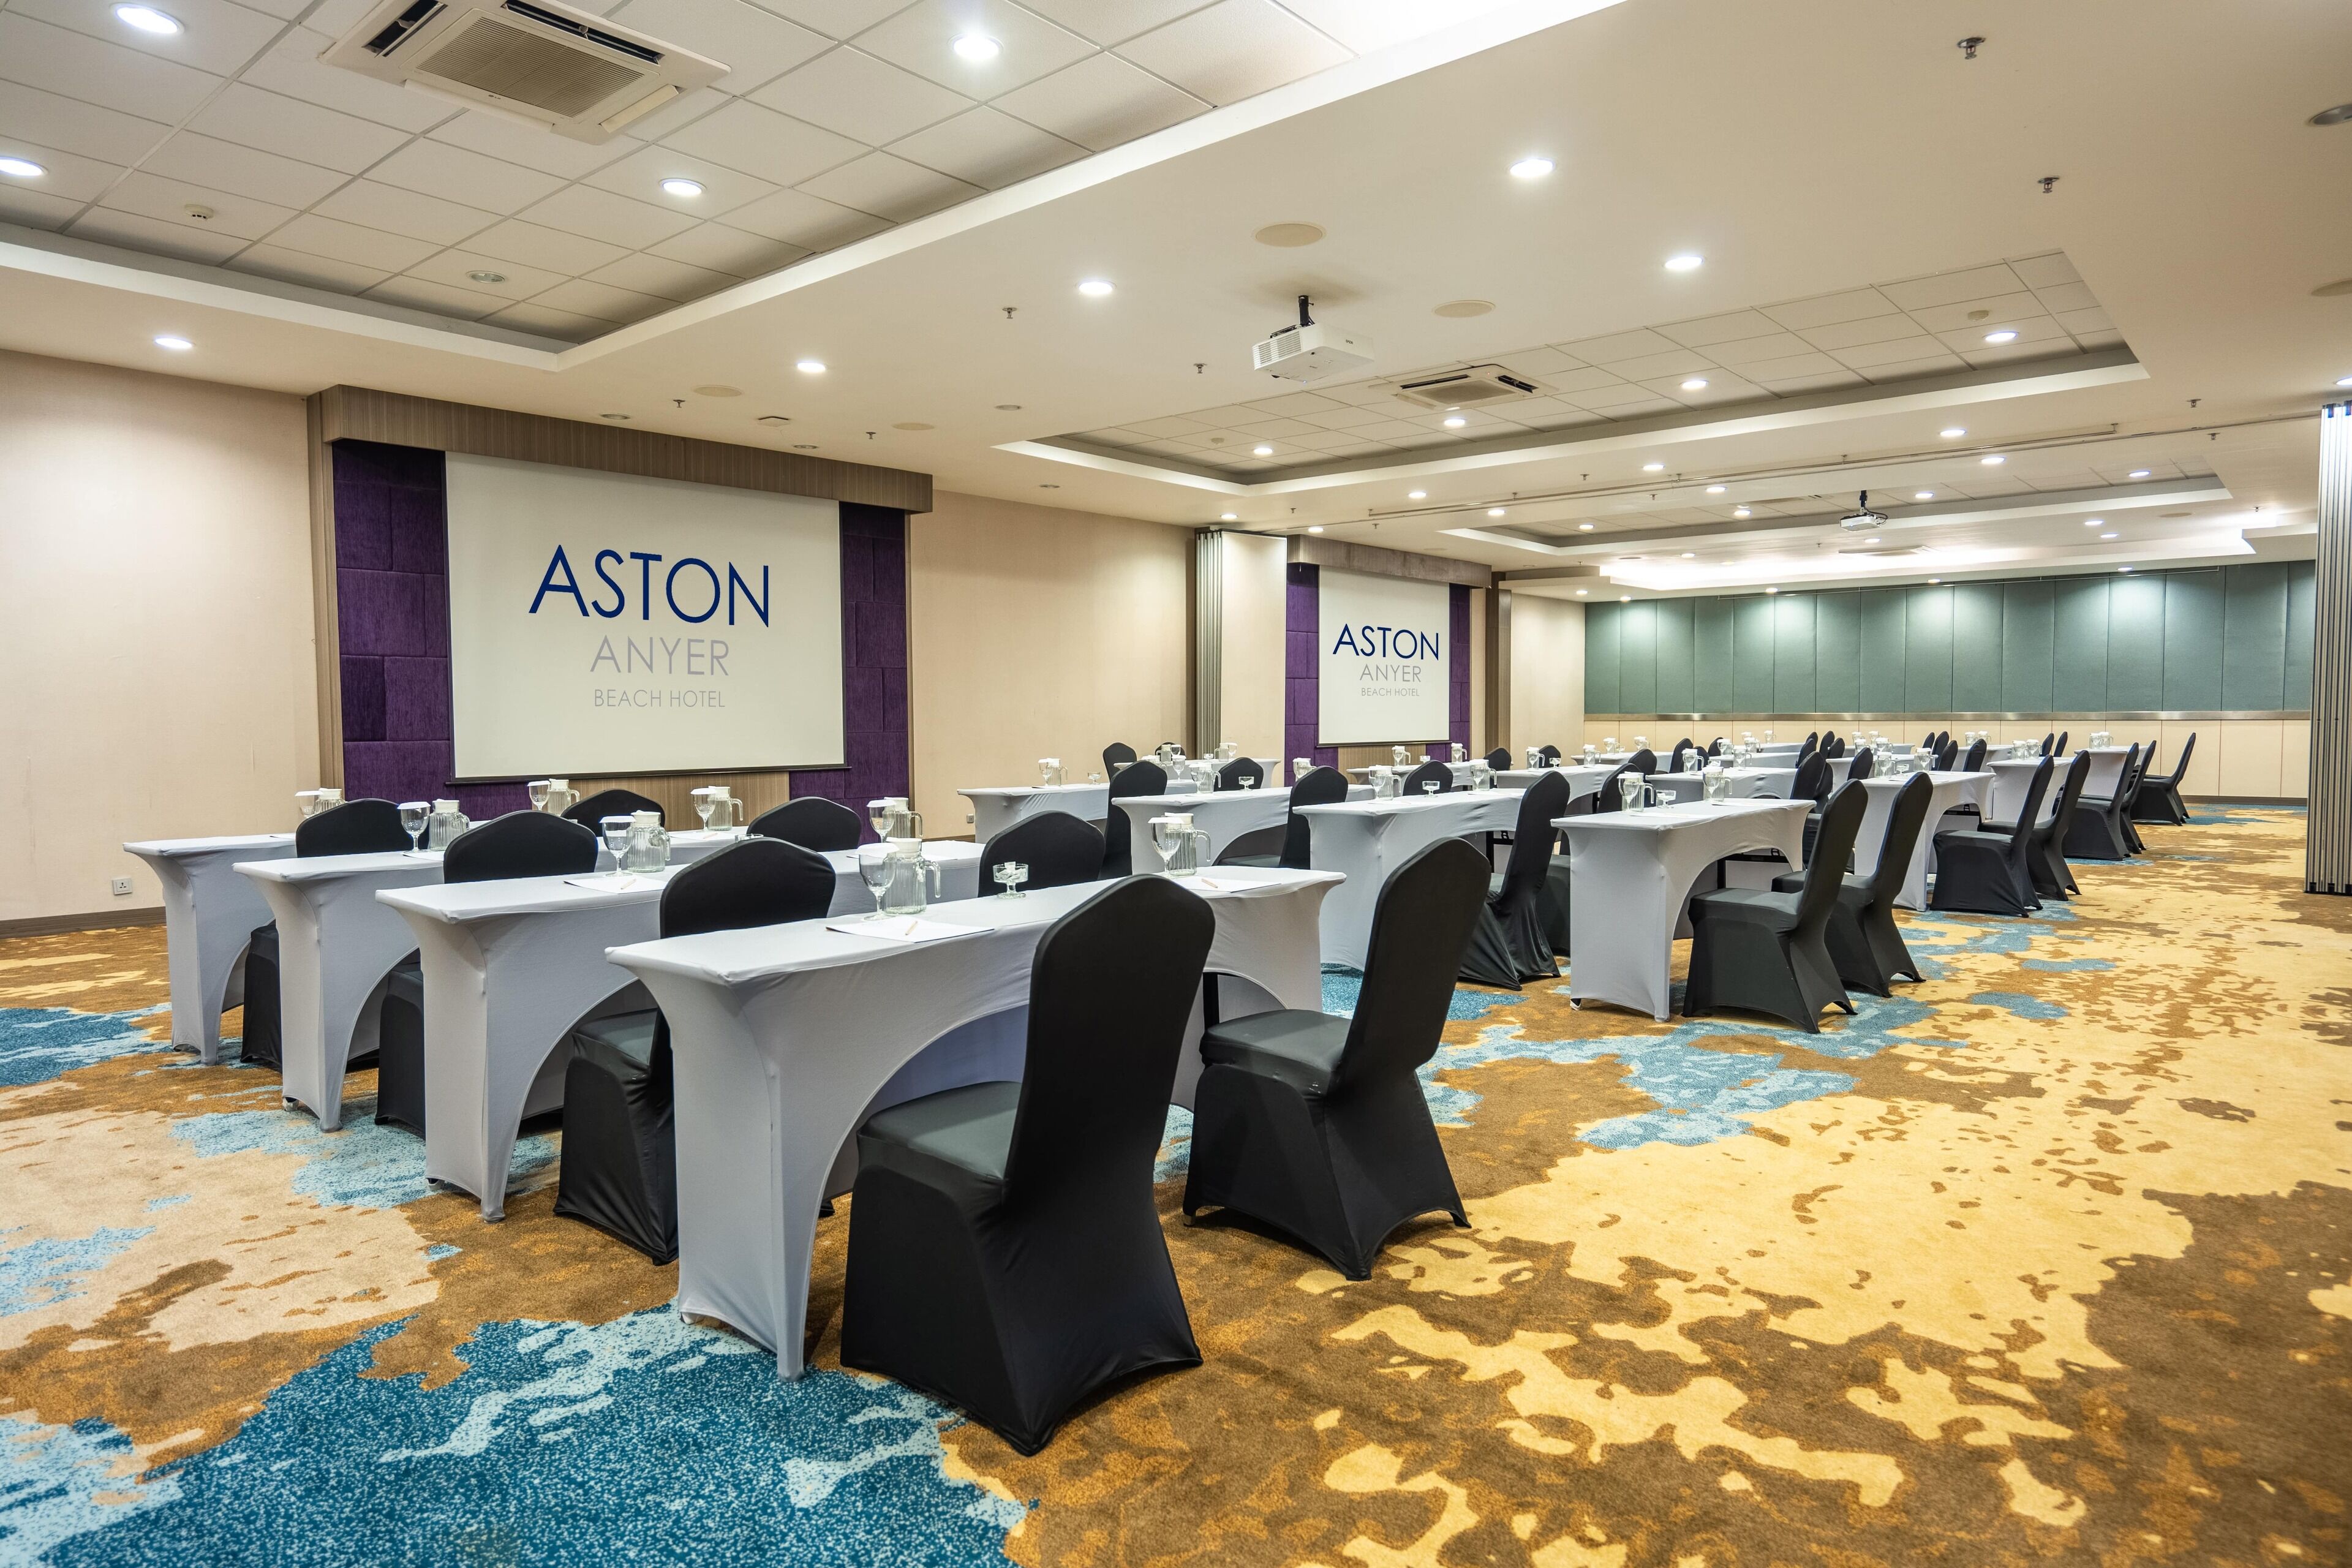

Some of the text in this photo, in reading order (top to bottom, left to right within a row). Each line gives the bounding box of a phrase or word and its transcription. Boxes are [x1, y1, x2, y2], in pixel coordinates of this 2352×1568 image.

[529, 544, 769, 628] ASTON
[590, 635, 729, 676] ANYER
[1332, 623, 1439, 661] ASTON
[1359, 663, 1422, 682] ANYER
[594, 689, 726, 707] BEACH HOTEL
[1361, 687, 1420, 696] BEACH HOTEL
